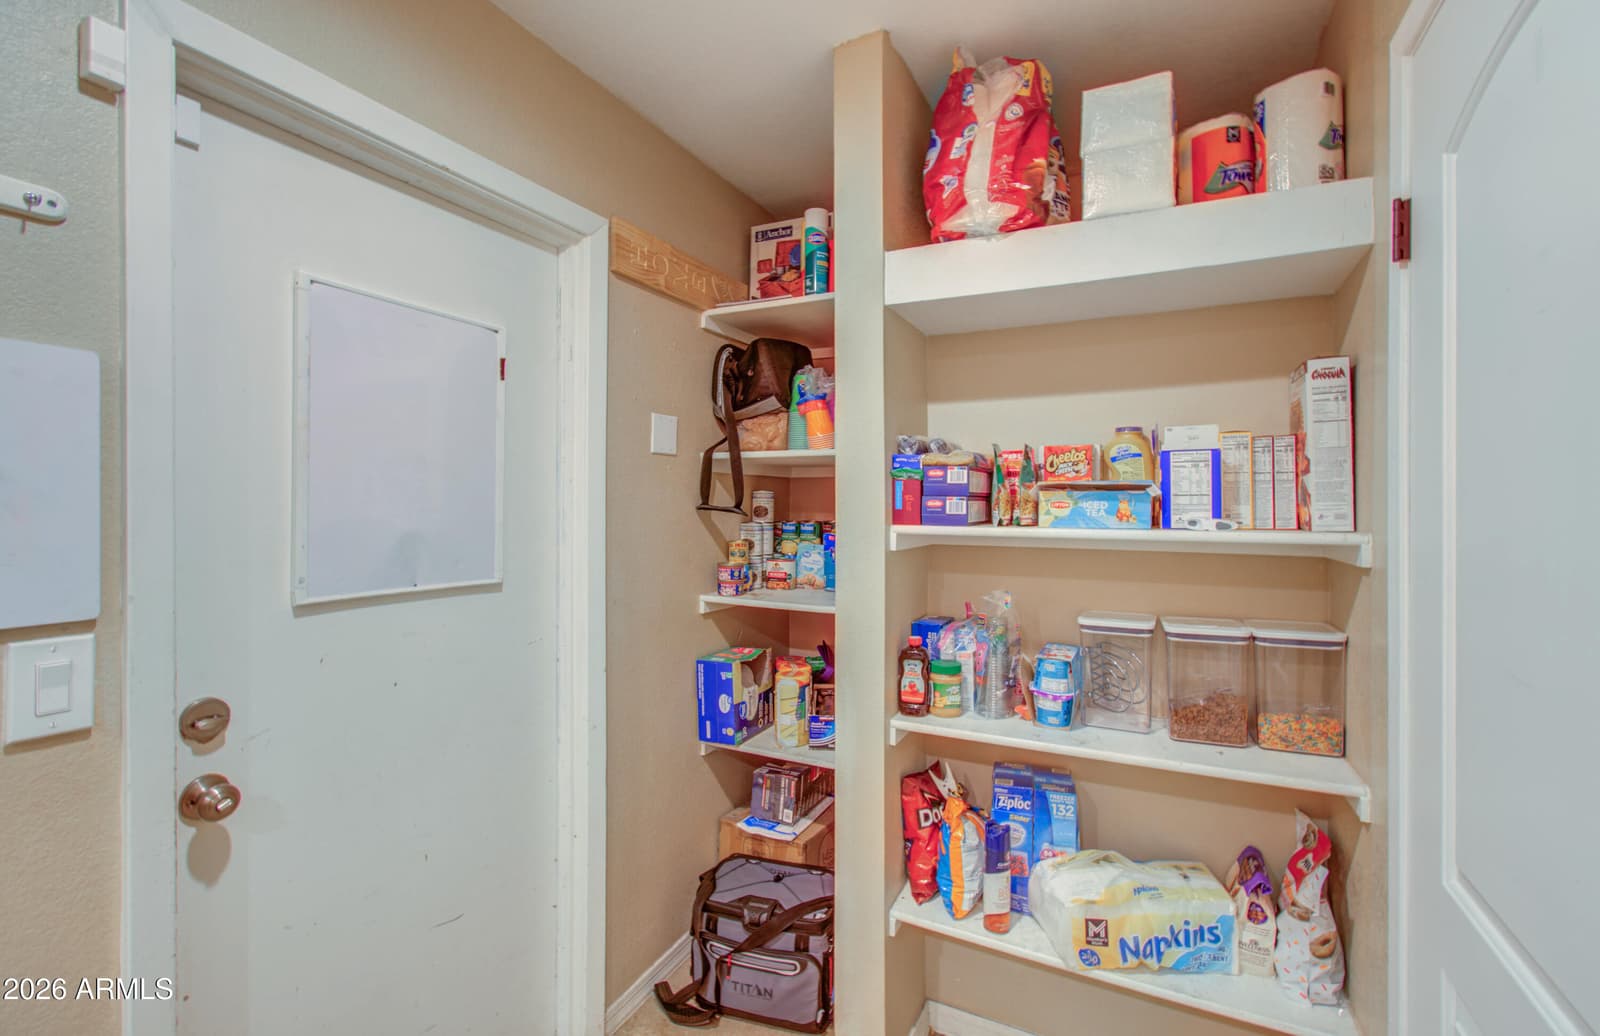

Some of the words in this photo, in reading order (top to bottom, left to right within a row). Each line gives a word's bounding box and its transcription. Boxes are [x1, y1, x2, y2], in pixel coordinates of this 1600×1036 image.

[767, 227, 791, 239] Anchor
[1046, 448, 1087, 473] Cheetos
[1087, 509, 1106, 517] TEA
[998, 795, 1032, 811] Ziploc
[1052, 803, 1075, 817] 132
[1119, 919, 1222, 965] Napkins
[731, 980, 774, 1000] TITAN
